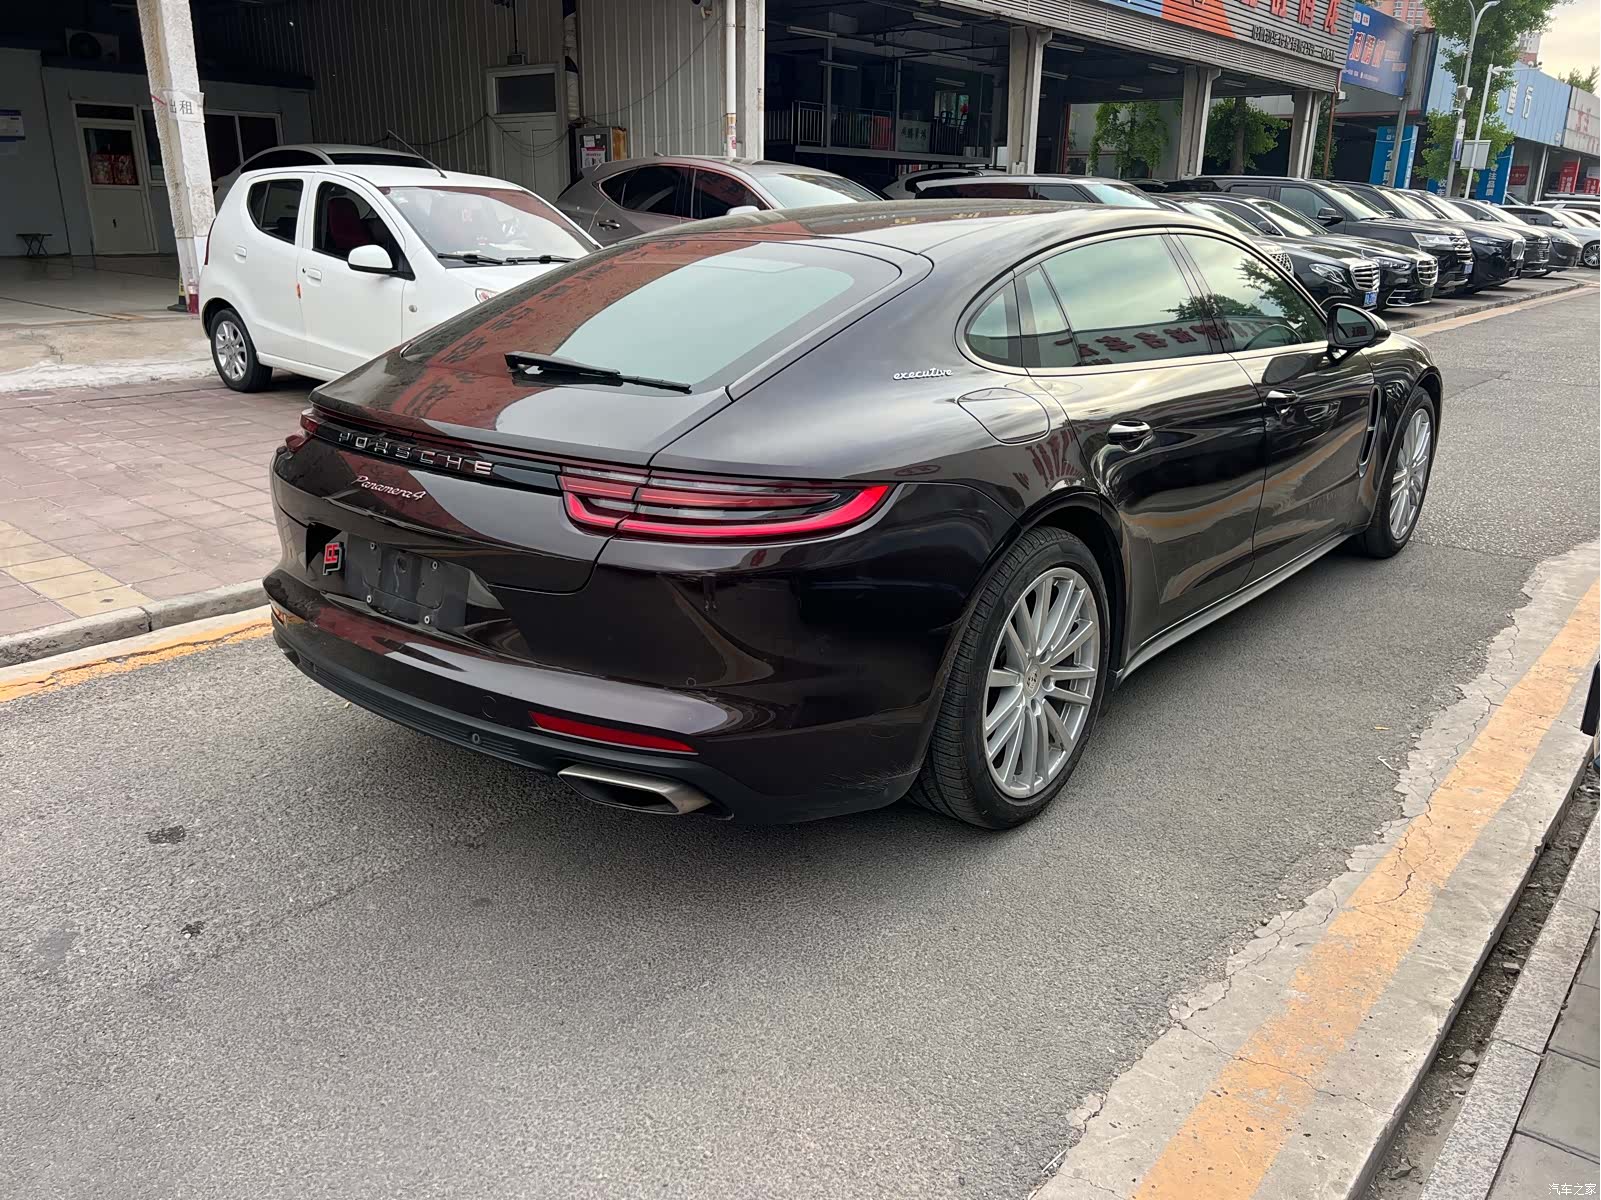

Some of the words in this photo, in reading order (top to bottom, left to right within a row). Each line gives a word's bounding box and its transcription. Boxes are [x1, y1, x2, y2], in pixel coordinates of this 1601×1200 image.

[170, 98, 194, 115] 出租
[893, 367, 953, 380] executive
[338, 431, 493, 476] PORSCHE
